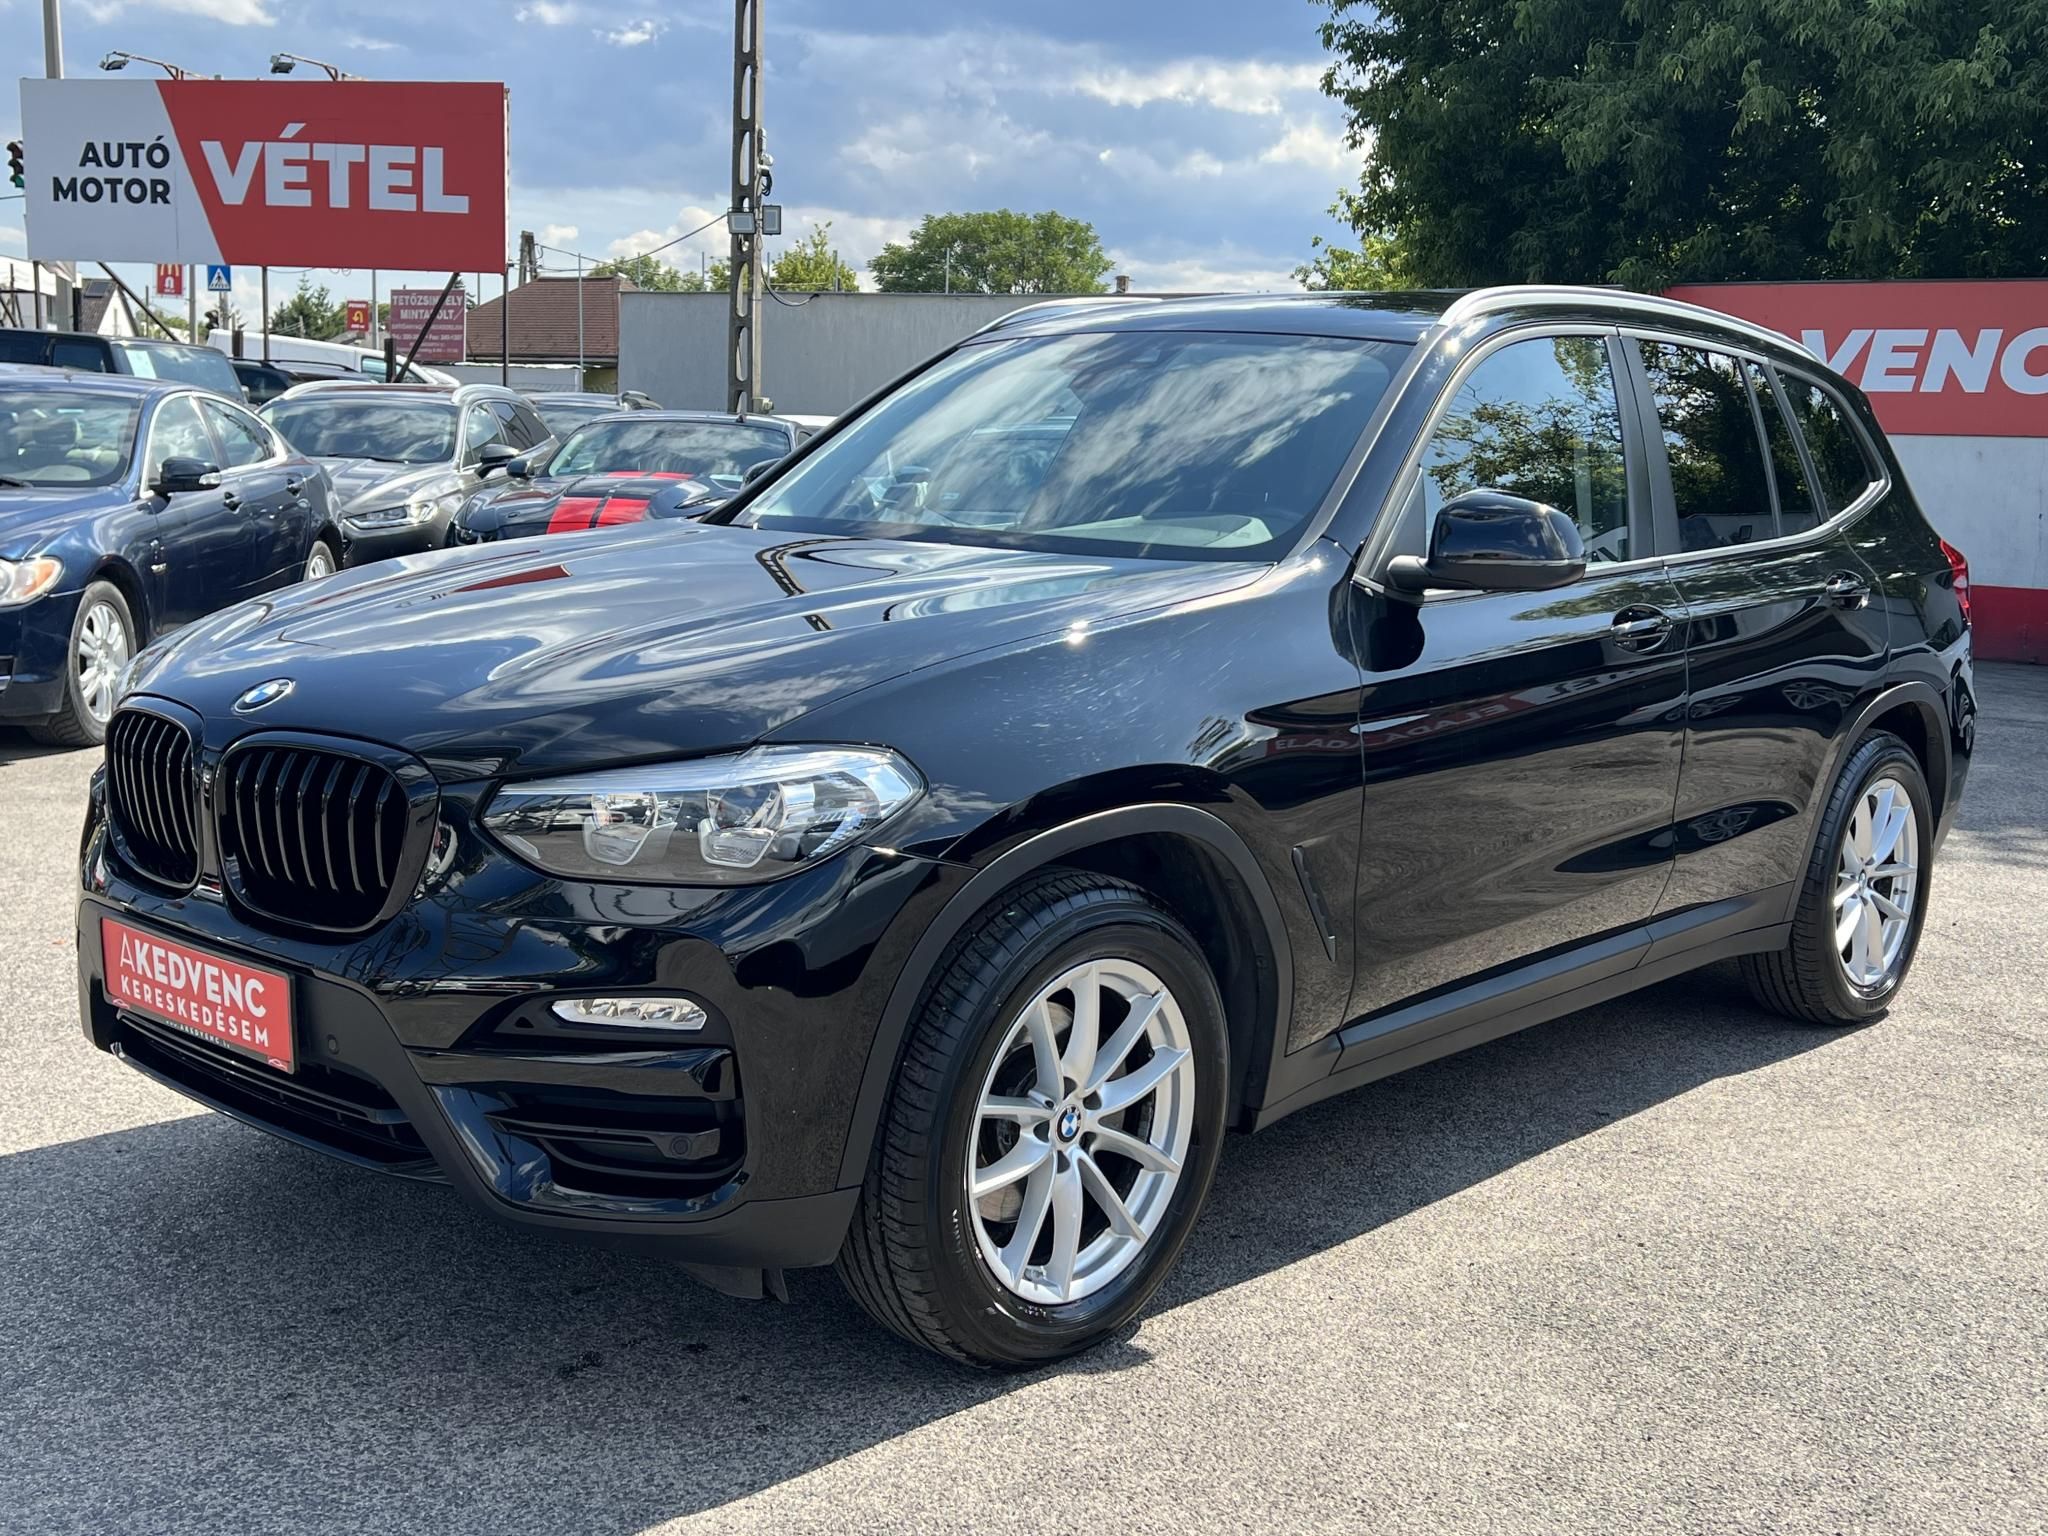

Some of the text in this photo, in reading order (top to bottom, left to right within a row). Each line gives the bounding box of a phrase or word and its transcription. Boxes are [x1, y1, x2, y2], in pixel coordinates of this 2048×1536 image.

[79, 135, 170, 169] AUTÓ
[200, 122, 469, 214] VÉTEL
[53, 176, 171, 205] MOTOR
[392, 292, 463, 306] TETŐZSINELY
[400, 309, 454, 320] MINTAOLT
[121, 974, 269, 1048] KERESKEDÉSEM
